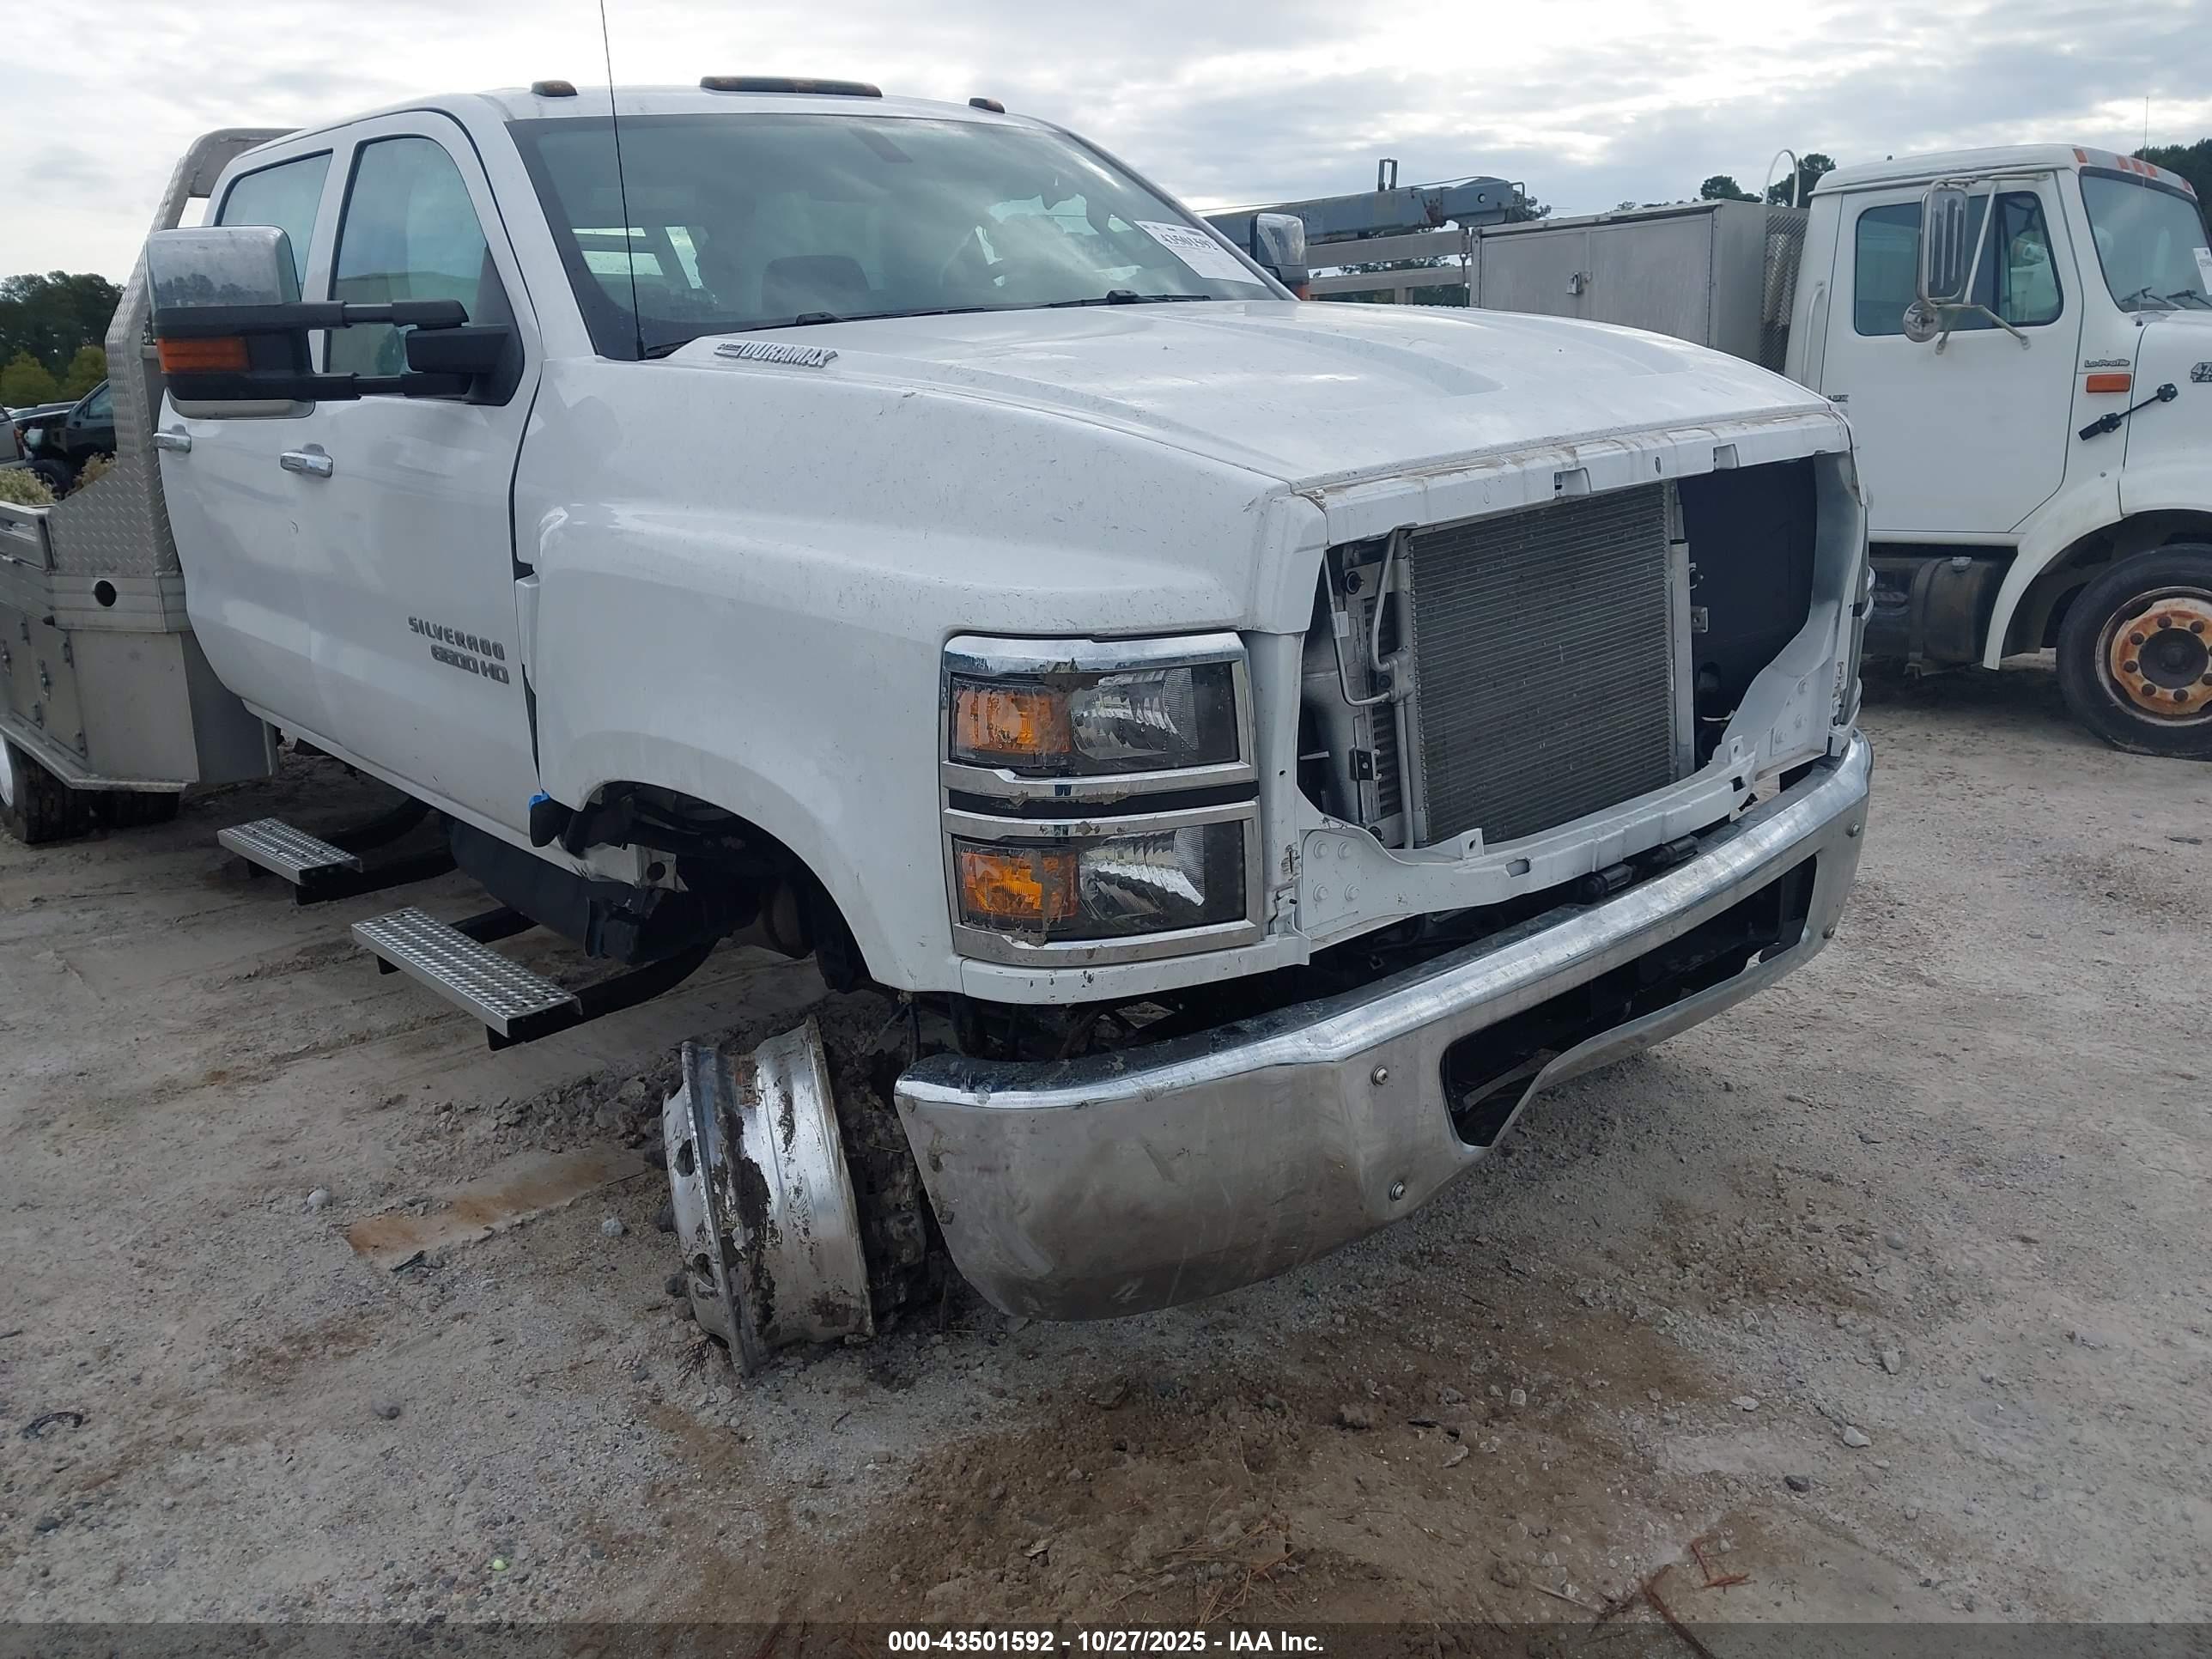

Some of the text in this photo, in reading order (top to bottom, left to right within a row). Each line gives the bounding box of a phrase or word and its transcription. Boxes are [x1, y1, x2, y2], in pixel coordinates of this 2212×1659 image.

[738, 341, 838, 368] DURAMAX
[2191, 362, 2212, 374] 47
[408, 616, 505, 660] SILVERADO
